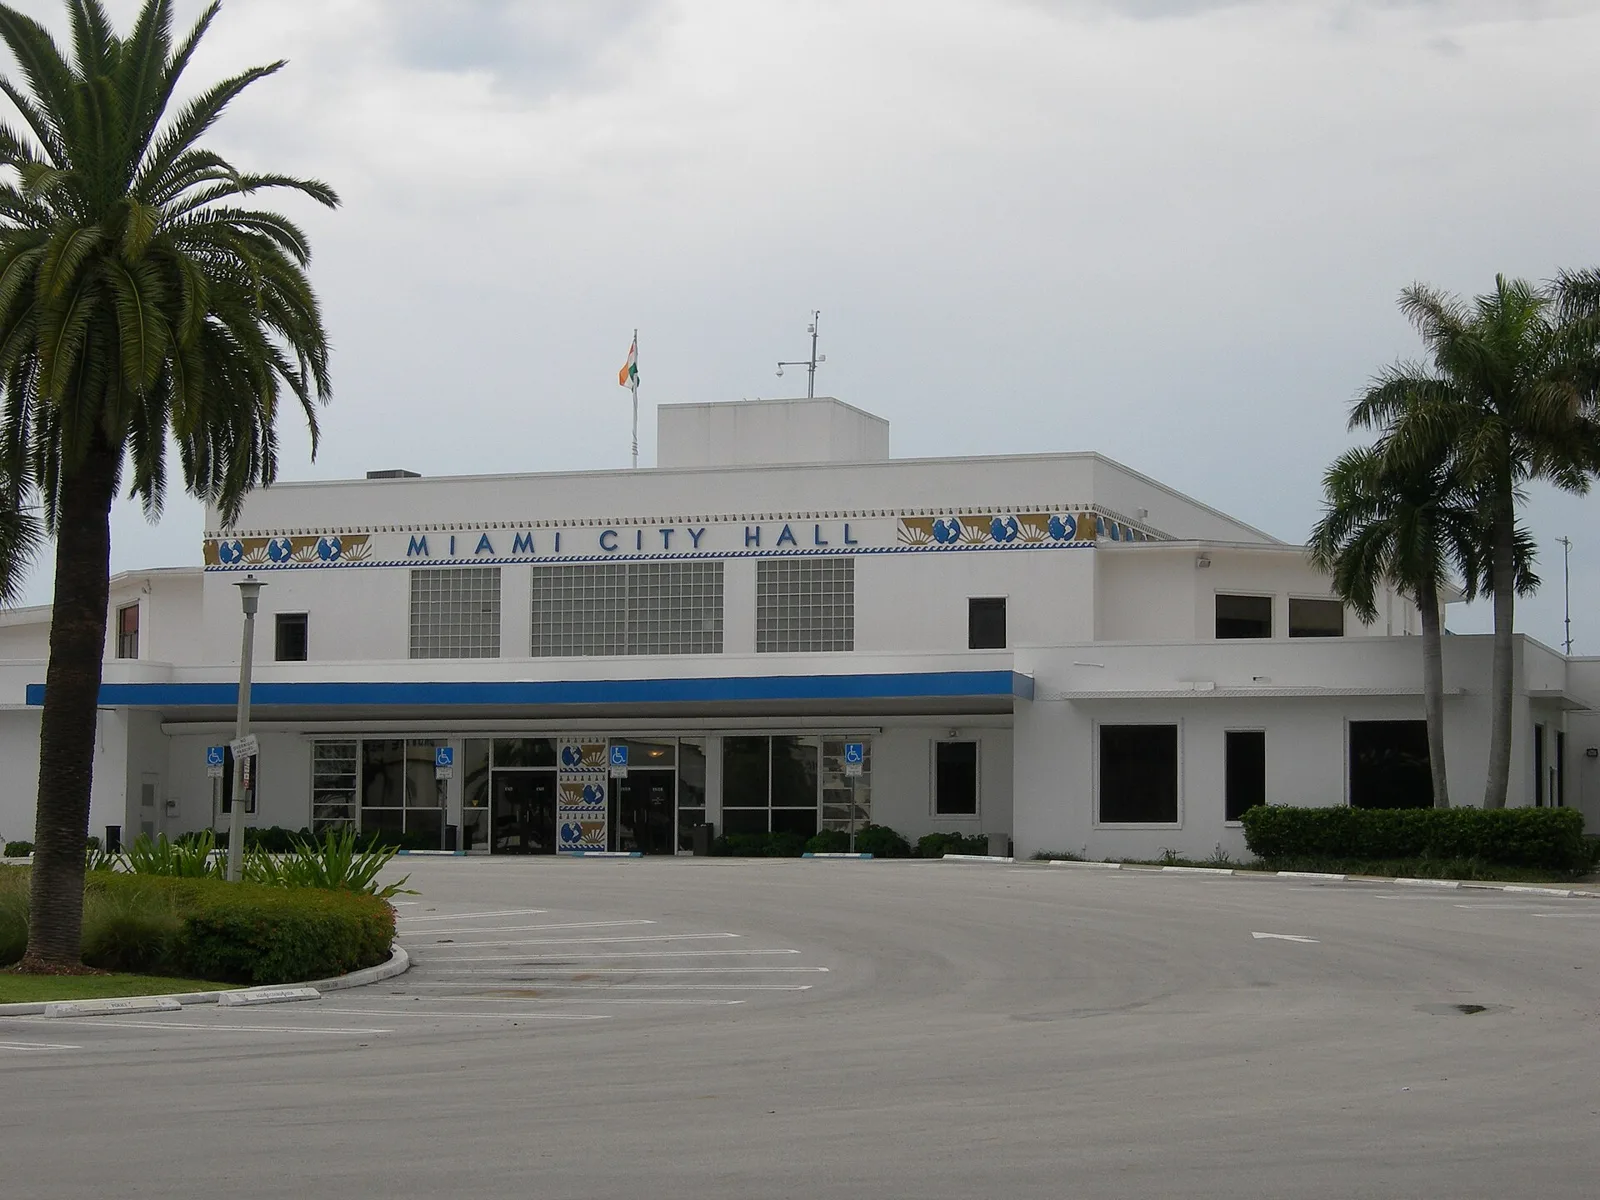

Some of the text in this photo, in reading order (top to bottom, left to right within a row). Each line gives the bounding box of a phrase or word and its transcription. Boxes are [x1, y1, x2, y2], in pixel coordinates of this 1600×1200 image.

[406, 523, 858, 557] MIAMI CITY HALL
